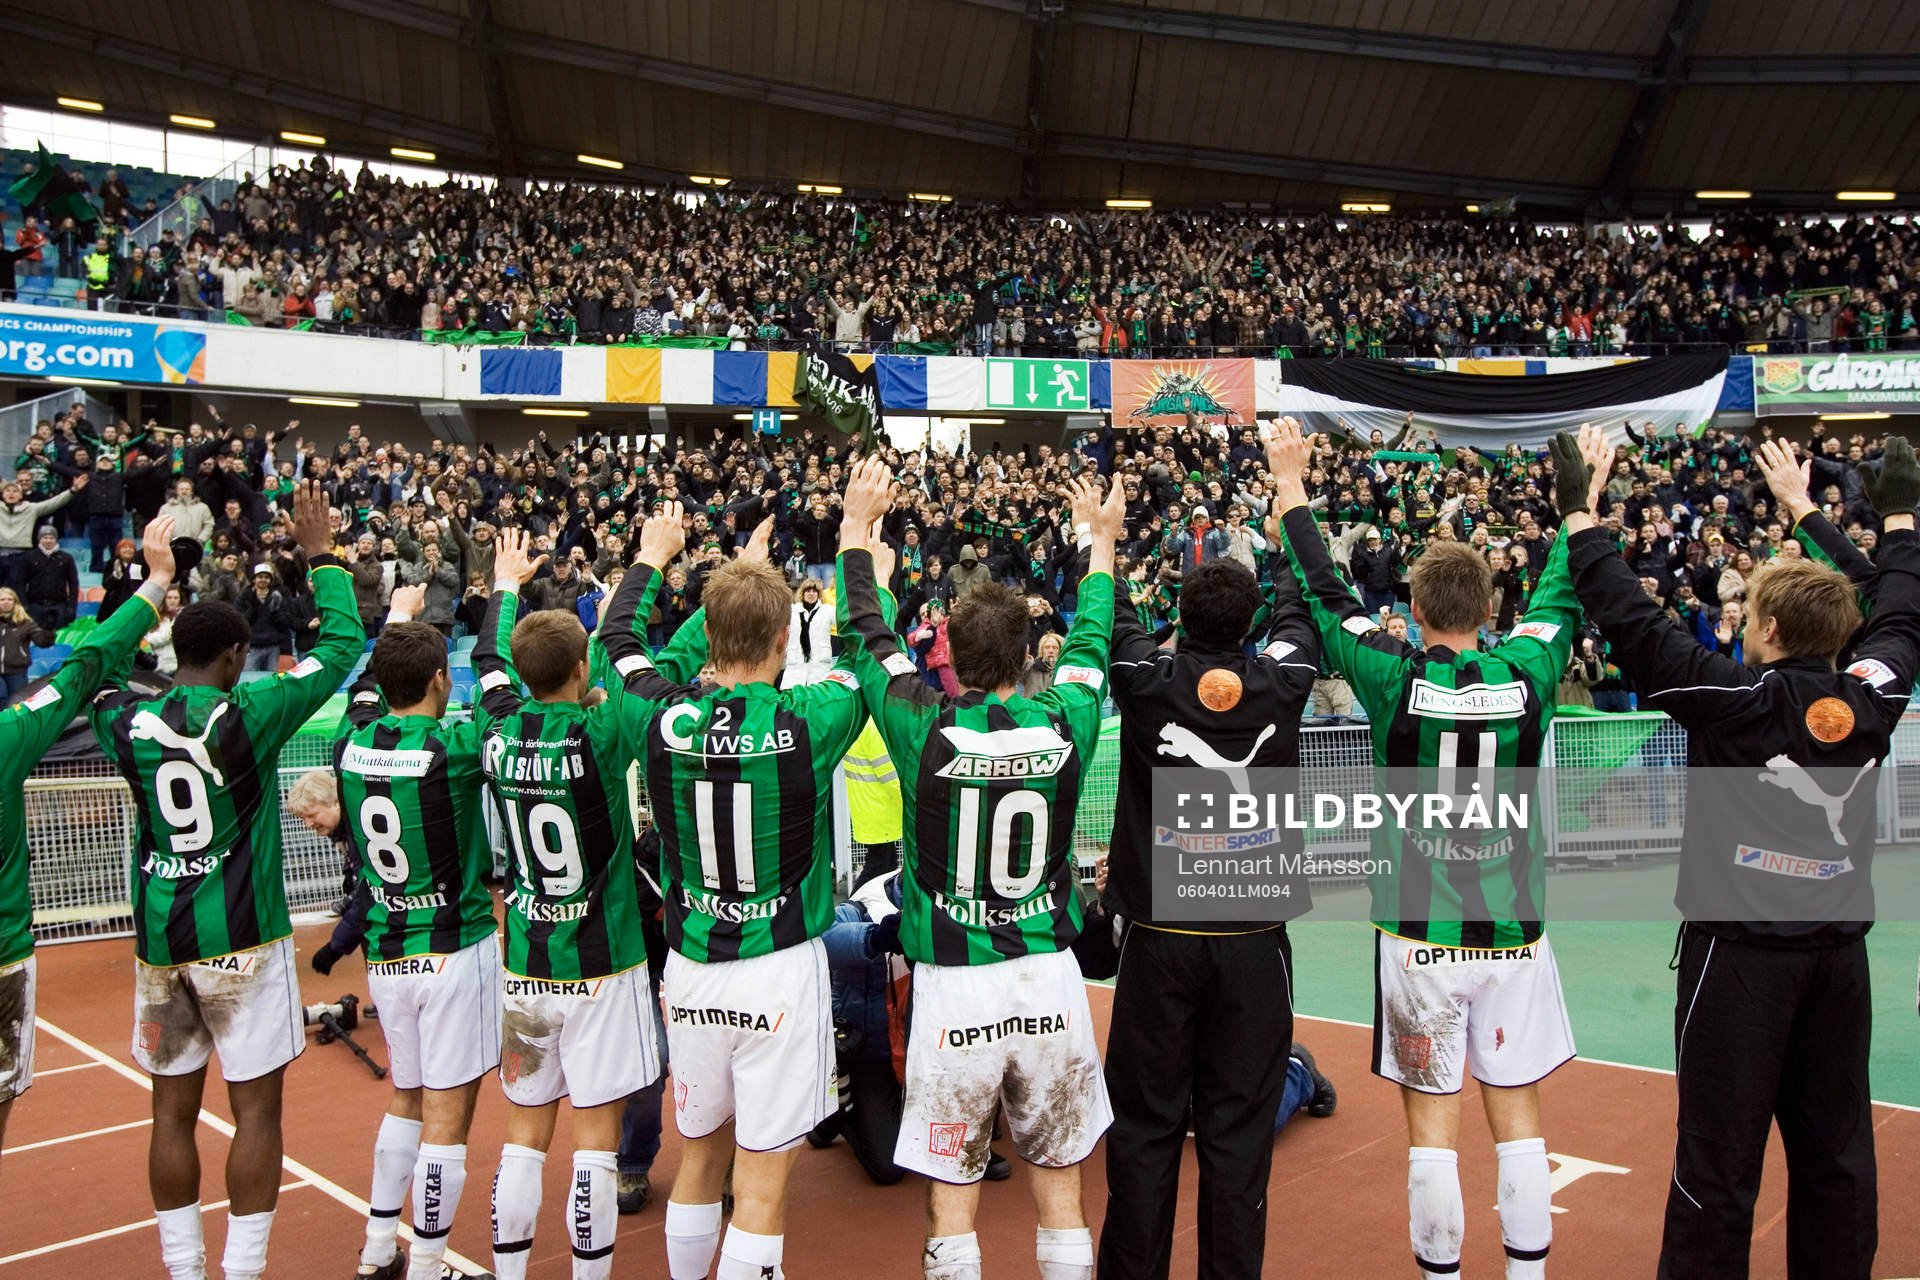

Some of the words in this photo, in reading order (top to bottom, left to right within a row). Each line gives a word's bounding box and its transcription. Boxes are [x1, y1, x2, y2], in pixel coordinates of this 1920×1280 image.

[24, 321, 133, 338] CHAMPIONSHIPS
[1847, 392, 1911, 403] MAXIMUM
[759, 411, 775, 429] H
[1420, 692, 1519, 708] KUNGSLEDEN
[710, 707, 732, 731] 2
[507, 736, 523, 748] Din
[712, 735, 755, 754] VVS
[761, 729, 794, 752] AB
[951, 754, 1061, 777] ARROW
[501, 785, 567, 796] www.roslov.se
[155, 761, 214, 854] 9
[360, 795, 410, 884] 8
[505, 799, 584, 897] 19
[695, 781, 757, 892] 11
[956, 787, 1049, 899] 10
[1174, 827, 1276, 852] INTERSPORT
[1405, 828, 1514, 861] Folksam
[1762, 853, 1845, 878] INTERSP
[933, 890, 1057, 927] Folksam
[367, 958, 434, 976] PTIMERA
[1415, 947, 1533, 966] OPTIMERA
[672, 1005, 770, 1032] OPTIMERA
[949, 1013, 1066, 1047] OPTIMERA
[425, 1170, 442, 1226] PEAB
[575, 1178, 592, 1244] PEAB
